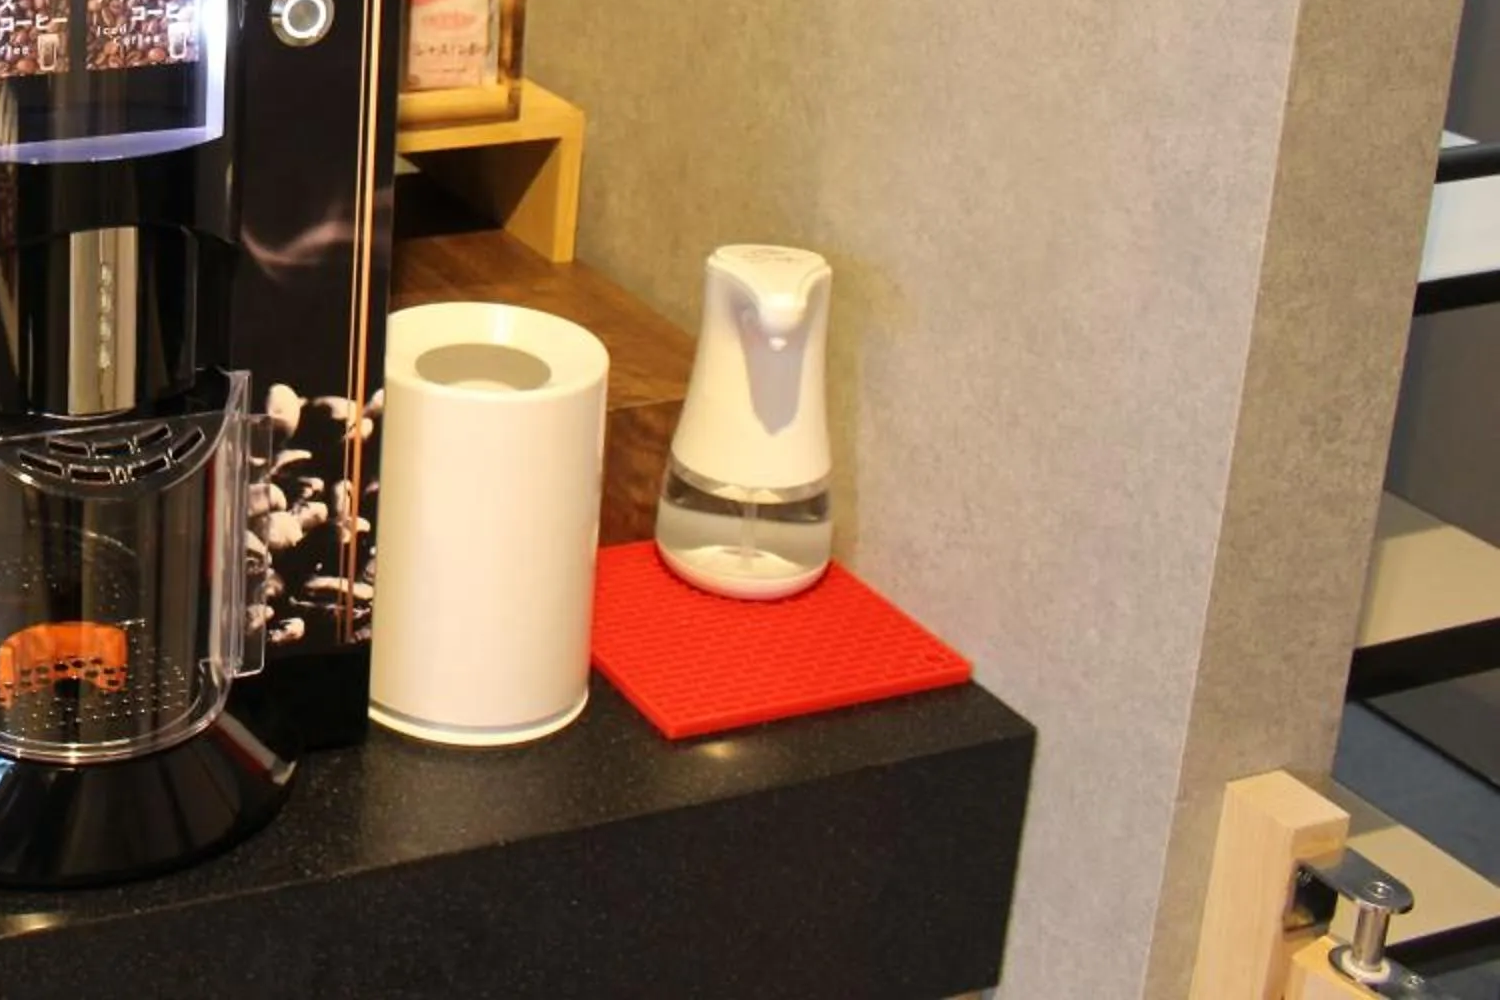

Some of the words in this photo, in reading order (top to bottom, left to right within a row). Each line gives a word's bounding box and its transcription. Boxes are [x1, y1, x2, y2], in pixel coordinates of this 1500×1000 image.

[131, 2, 190, 21] コーヒ
[0, 11, 68, 33] コーヒー
